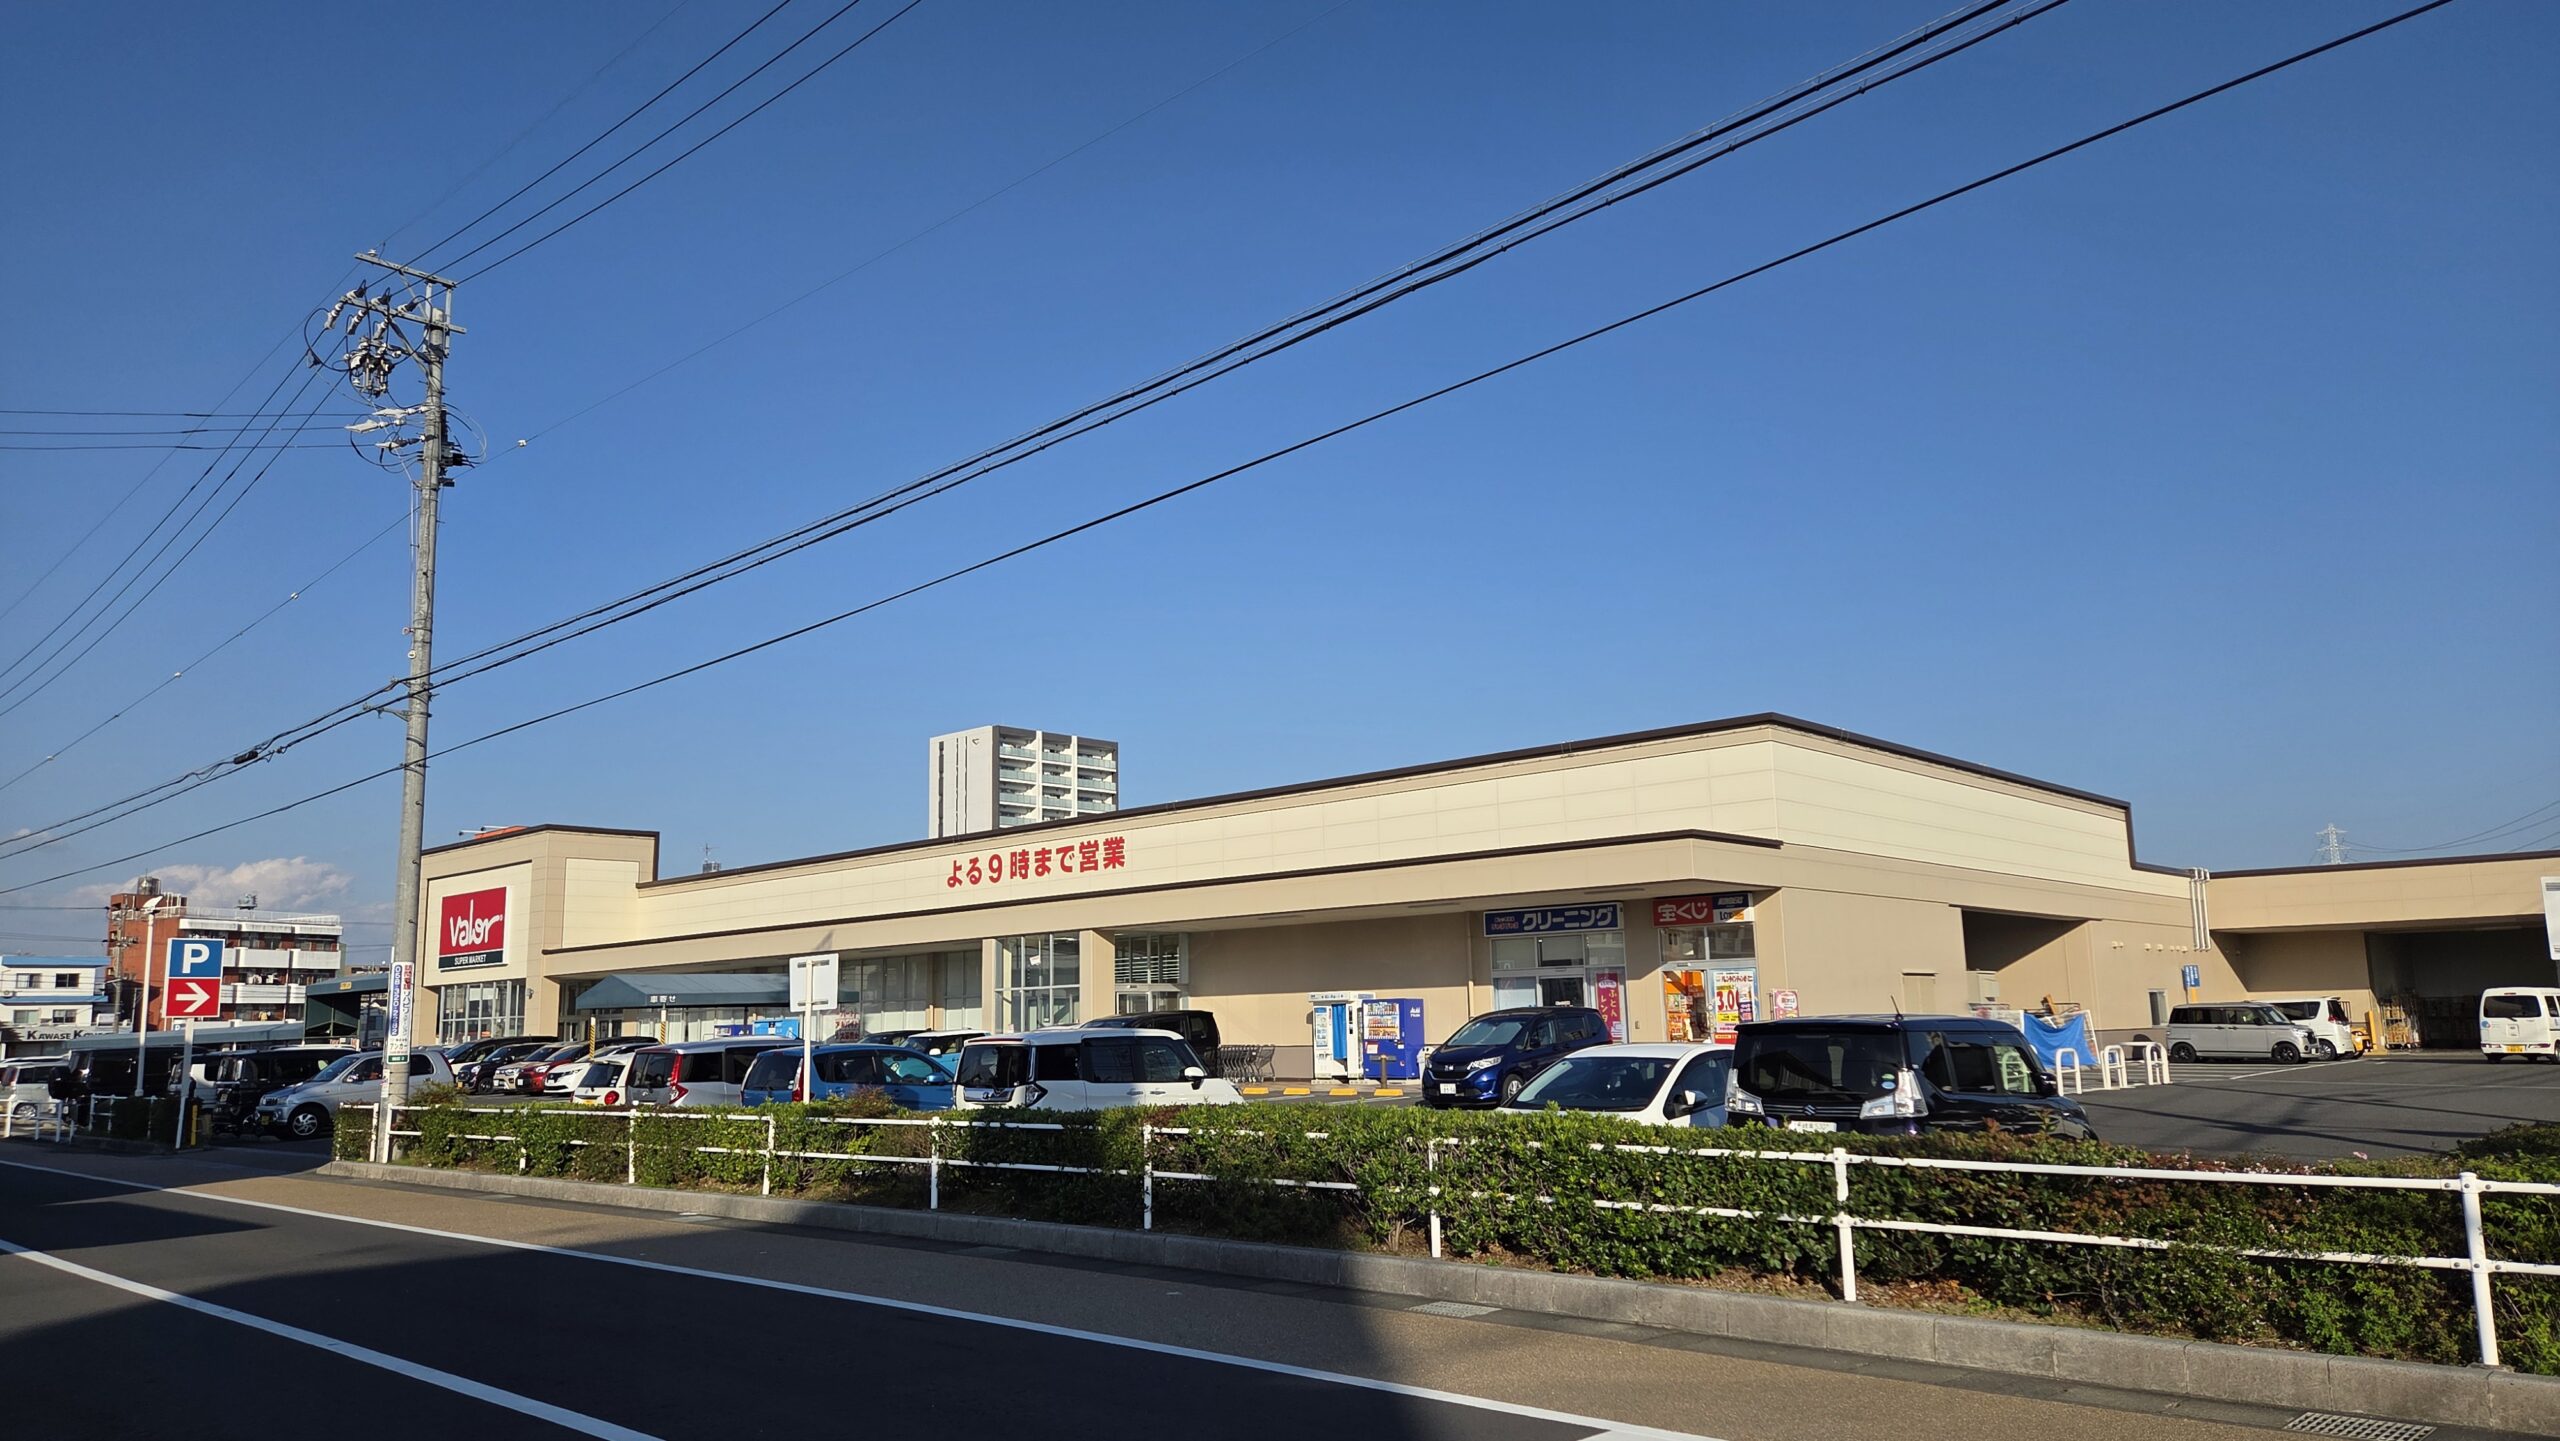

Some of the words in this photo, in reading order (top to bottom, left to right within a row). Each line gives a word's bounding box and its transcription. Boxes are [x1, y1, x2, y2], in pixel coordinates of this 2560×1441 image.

[947, 836, 1125, 888] よる9時まで営業
[1522, 906, 1614, 931] クリーニング
[1657, 901, 1708, 922] 宝くじ
[182, 943, 210, 974] P
[454, 956, 469, 965] SUPER
[469, 954, 487, 964] MARKET
[1608, 989, 1618, 1017] ふとん
[26, 1030, 71, 1040] KAWASE
